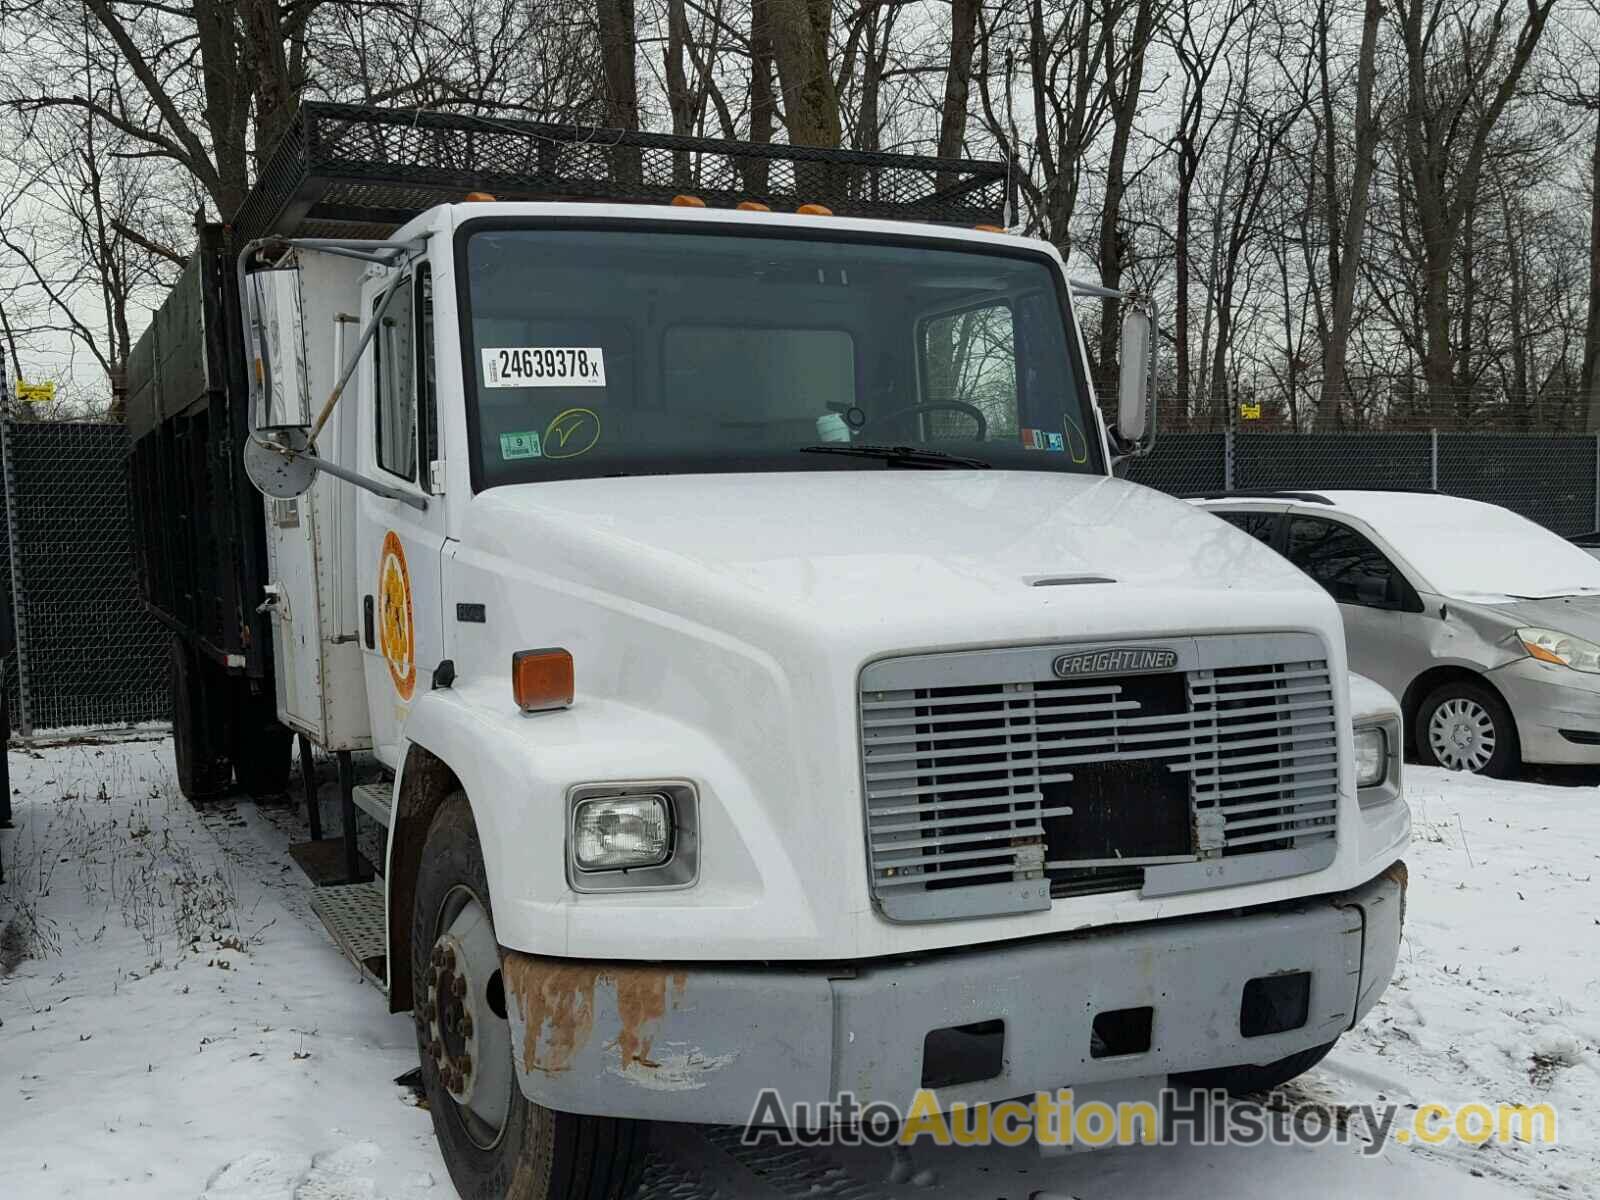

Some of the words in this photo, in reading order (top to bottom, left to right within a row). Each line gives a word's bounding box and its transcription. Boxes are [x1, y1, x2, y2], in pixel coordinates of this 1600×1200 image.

[500, 350, 589, 378] 24639378
[516, 438, 524, 447] 9
[1061, 651, 1175, 673] FREIGHTLINER
